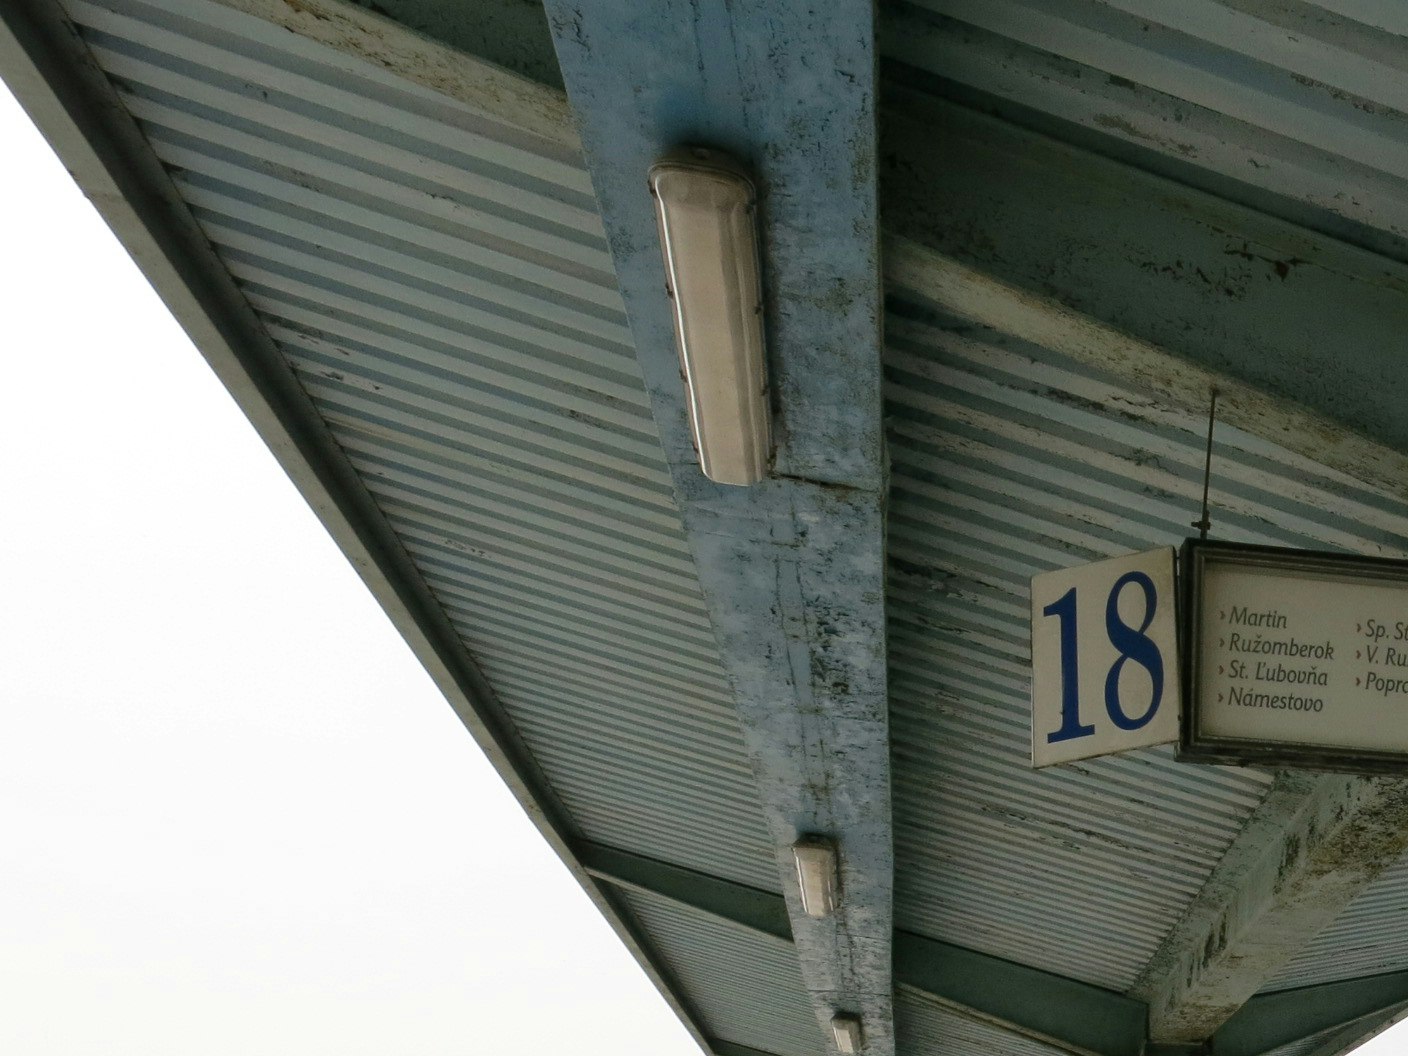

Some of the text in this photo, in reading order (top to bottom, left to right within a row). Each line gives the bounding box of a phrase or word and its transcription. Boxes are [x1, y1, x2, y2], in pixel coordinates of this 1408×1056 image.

[1228, 606, 1287, 629] Martin
[1365, 619, 1389, 643] Sp.
[1042, 571, 1165, 744] 18
[1228, 632, 1335, 660] Ružomberok
[1366, 645, 1379, 664] V.
[1228, 659, 1329, 686] St. Ľubovňa
[1227, 686, 1324, 712] Námestovo
